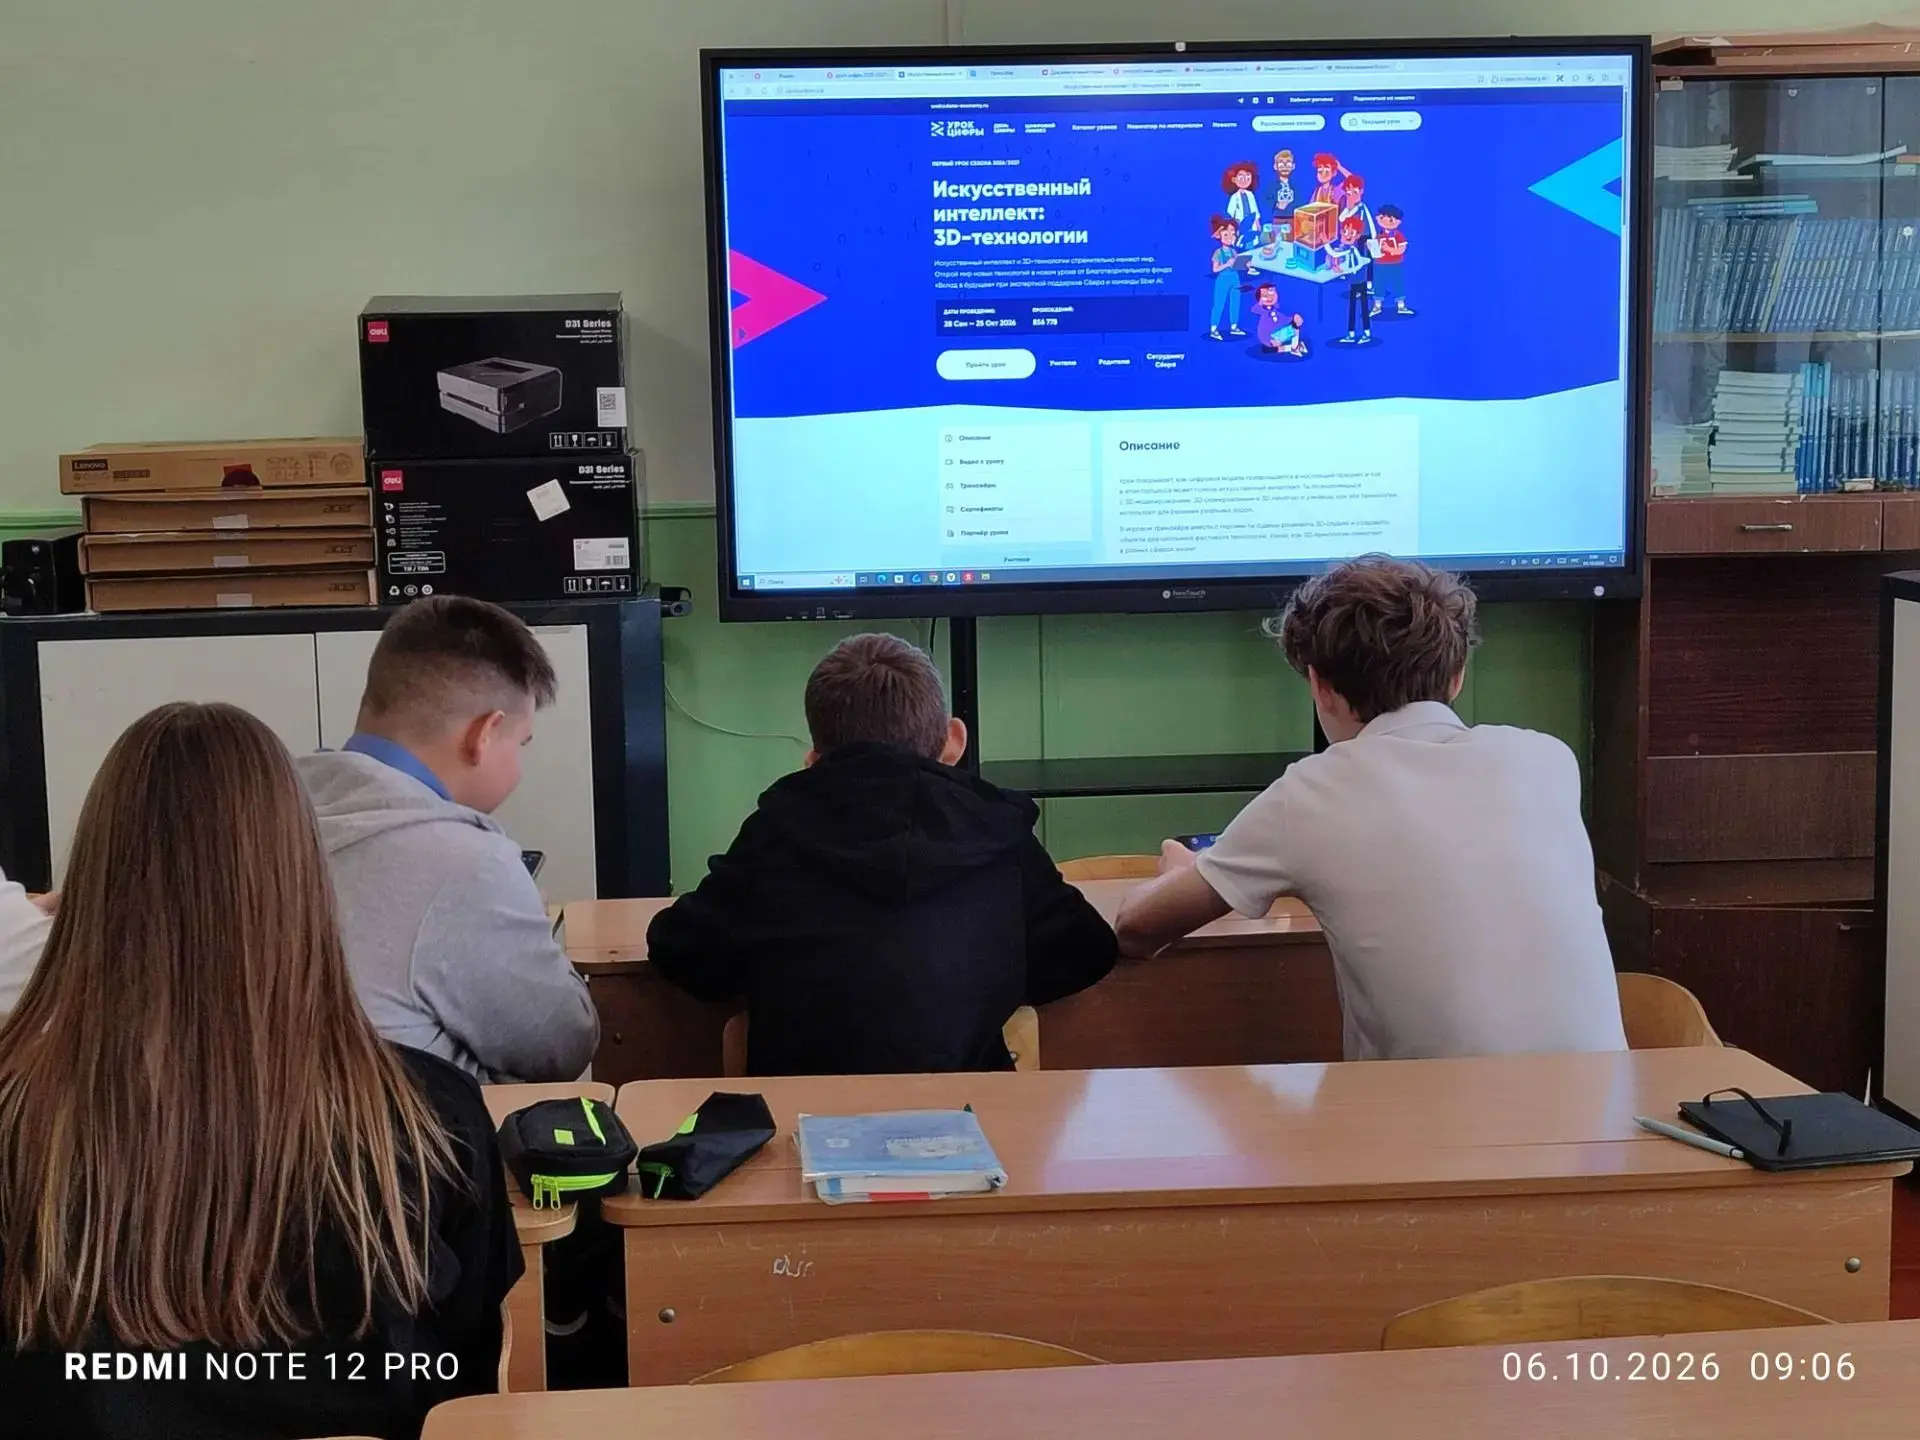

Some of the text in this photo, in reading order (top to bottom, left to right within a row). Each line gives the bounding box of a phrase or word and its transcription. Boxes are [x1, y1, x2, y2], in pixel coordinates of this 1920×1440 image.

[947, 121, 974, 129] УРОК
[947, 129, 984, 137] ЦИФРЫ
[933, 178, 1091, 201] Искусственный
[933, 207, 1045, 222] интеллект:
[933, 228, 1088, 246] 3D-технологии
[565, 318, 612, 328] D31 Series
[953, 319, 968, 327] Сен
[976, 319, 985, 327] 25
[986, 319, 999, 327] Окт
[369, 328, 387, 336] deli
[1146, 352, 1185, 361] Сотруднику
[1049, 359, 1077, 367] Учителю
[1098, 358, 1130, 366] Родителю
[1155, 361, 1176, 369] Сбера
[1119, 440, 1180, 451] Описание
[578, 464, 624, 474] D31 Series
[383, 476, 401, 484] deli
[323, 503, 355, 513] acer
[325, 544, 358, 554] acer
[328, 583, 359, 592] acer
